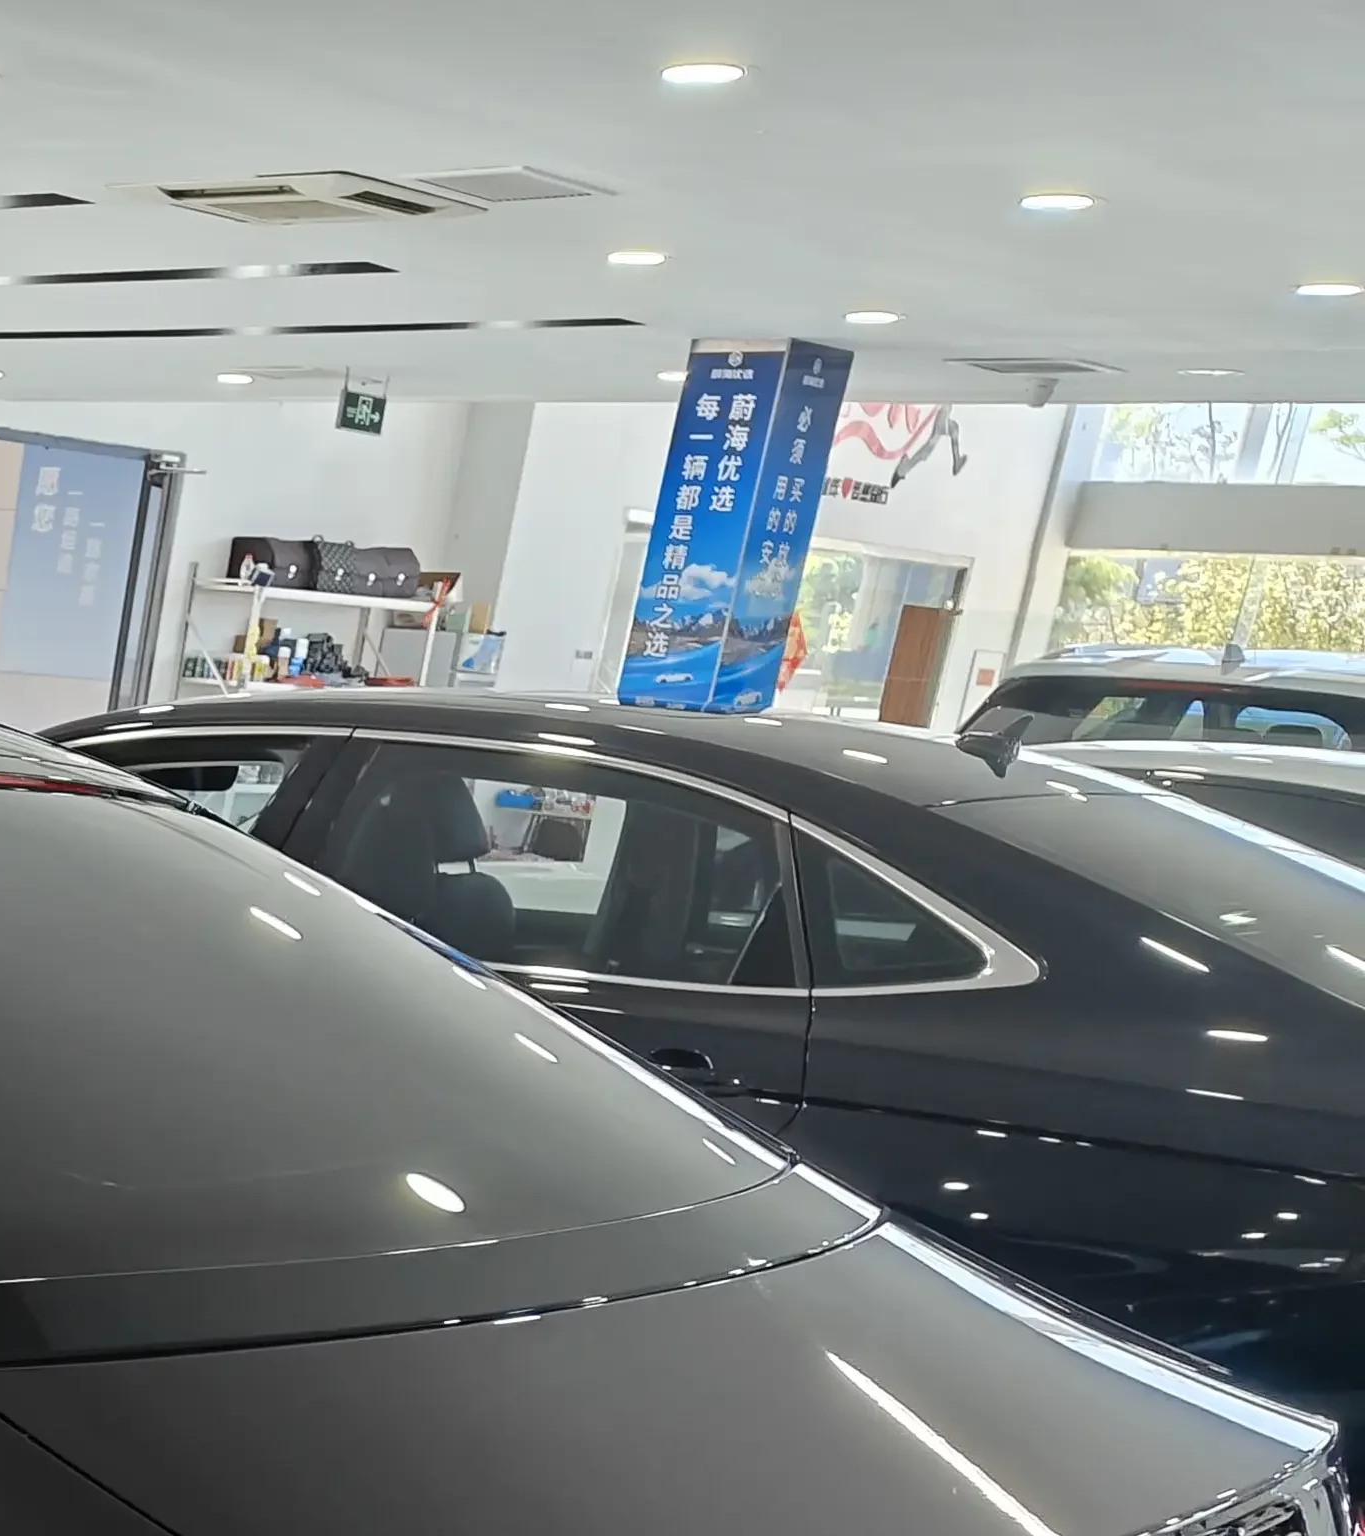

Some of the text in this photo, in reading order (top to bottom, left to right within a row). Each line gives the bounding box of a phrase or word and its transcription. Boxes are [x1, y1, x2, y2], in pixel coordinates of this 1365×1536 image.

[643, 393, 721, 658] 每一辆都是精品之选
[709, 394, 757, 512] 蔚海优选
